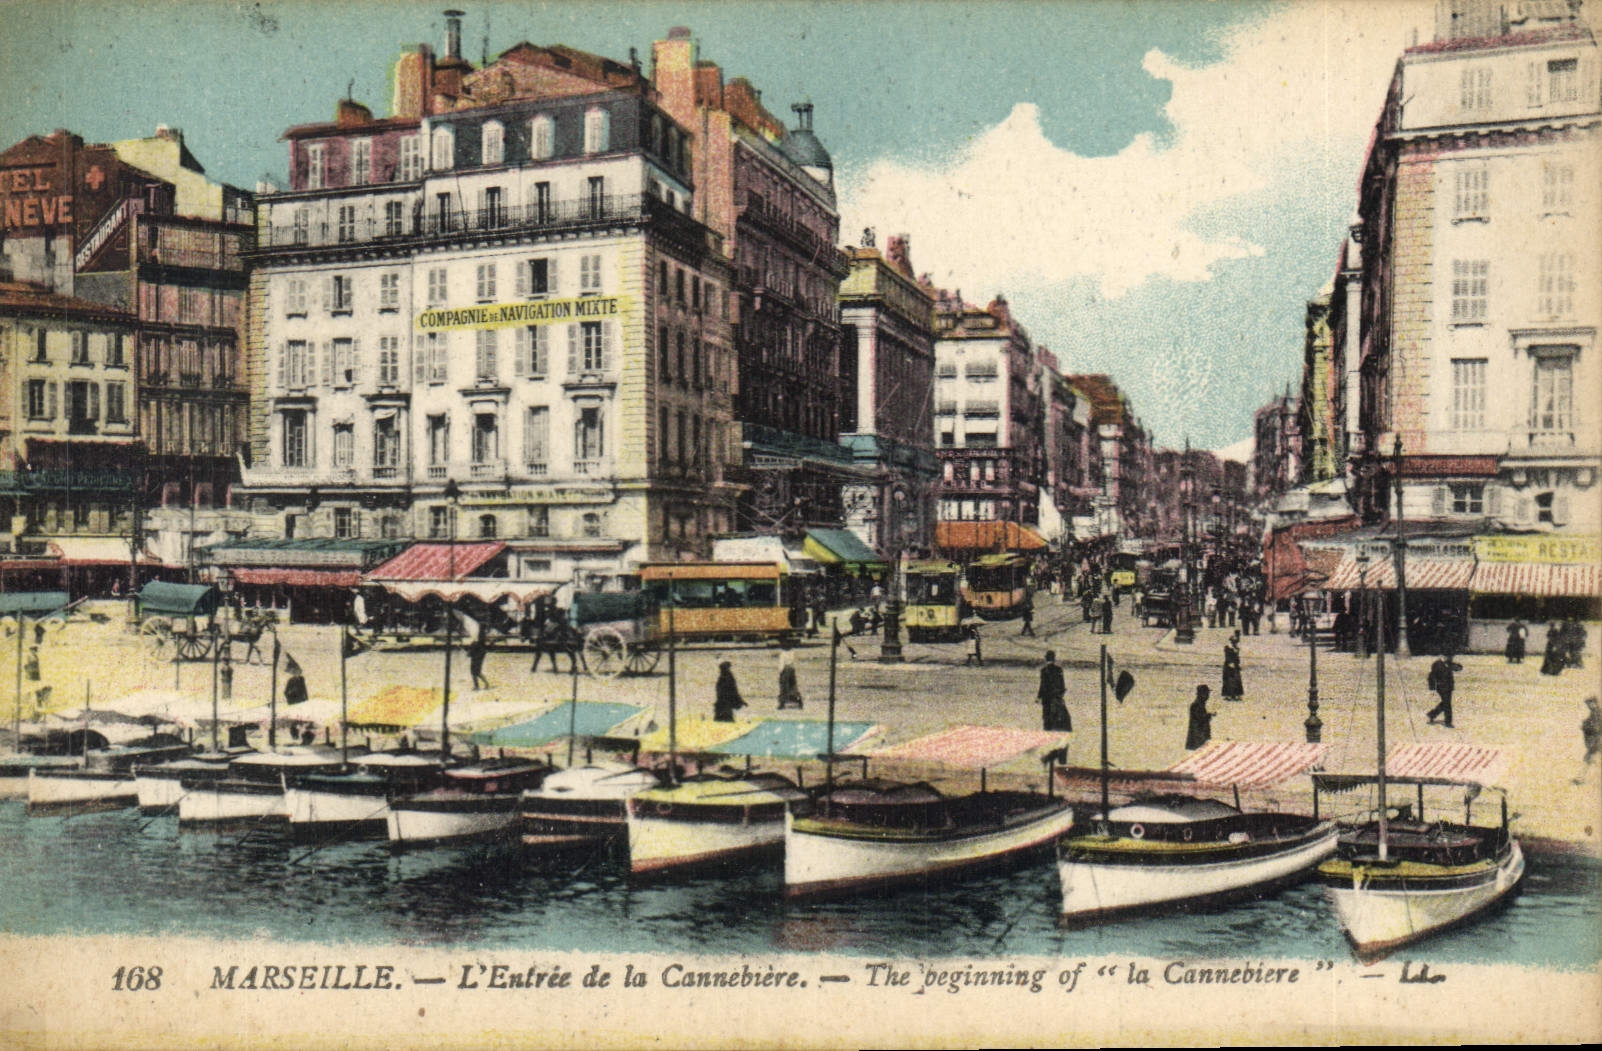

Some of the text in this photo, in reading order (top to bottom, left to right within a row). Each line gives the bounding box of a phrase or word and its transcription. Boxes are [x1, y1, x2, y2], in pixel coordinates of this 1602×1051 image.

[420, 308, 489, 328] COMPAGNIE
[499, 302, 571, 322] NAVIGATION
[575, 298, 618, 316] MIXTE
[113, 966, 163, 991] 168
[210, 965, 402, 990] MARSEILLE.
[457, 964, 572, 990] L'Entrée
[583, 964, 611, 988] de
[624, 964, 647, 988] la
[661, 963, 808, 988] Cannebière.
[865, 962, 910, 987] The
[924, 963, 1047, 994] beginning
[1058, 962, 1087, 993] of
